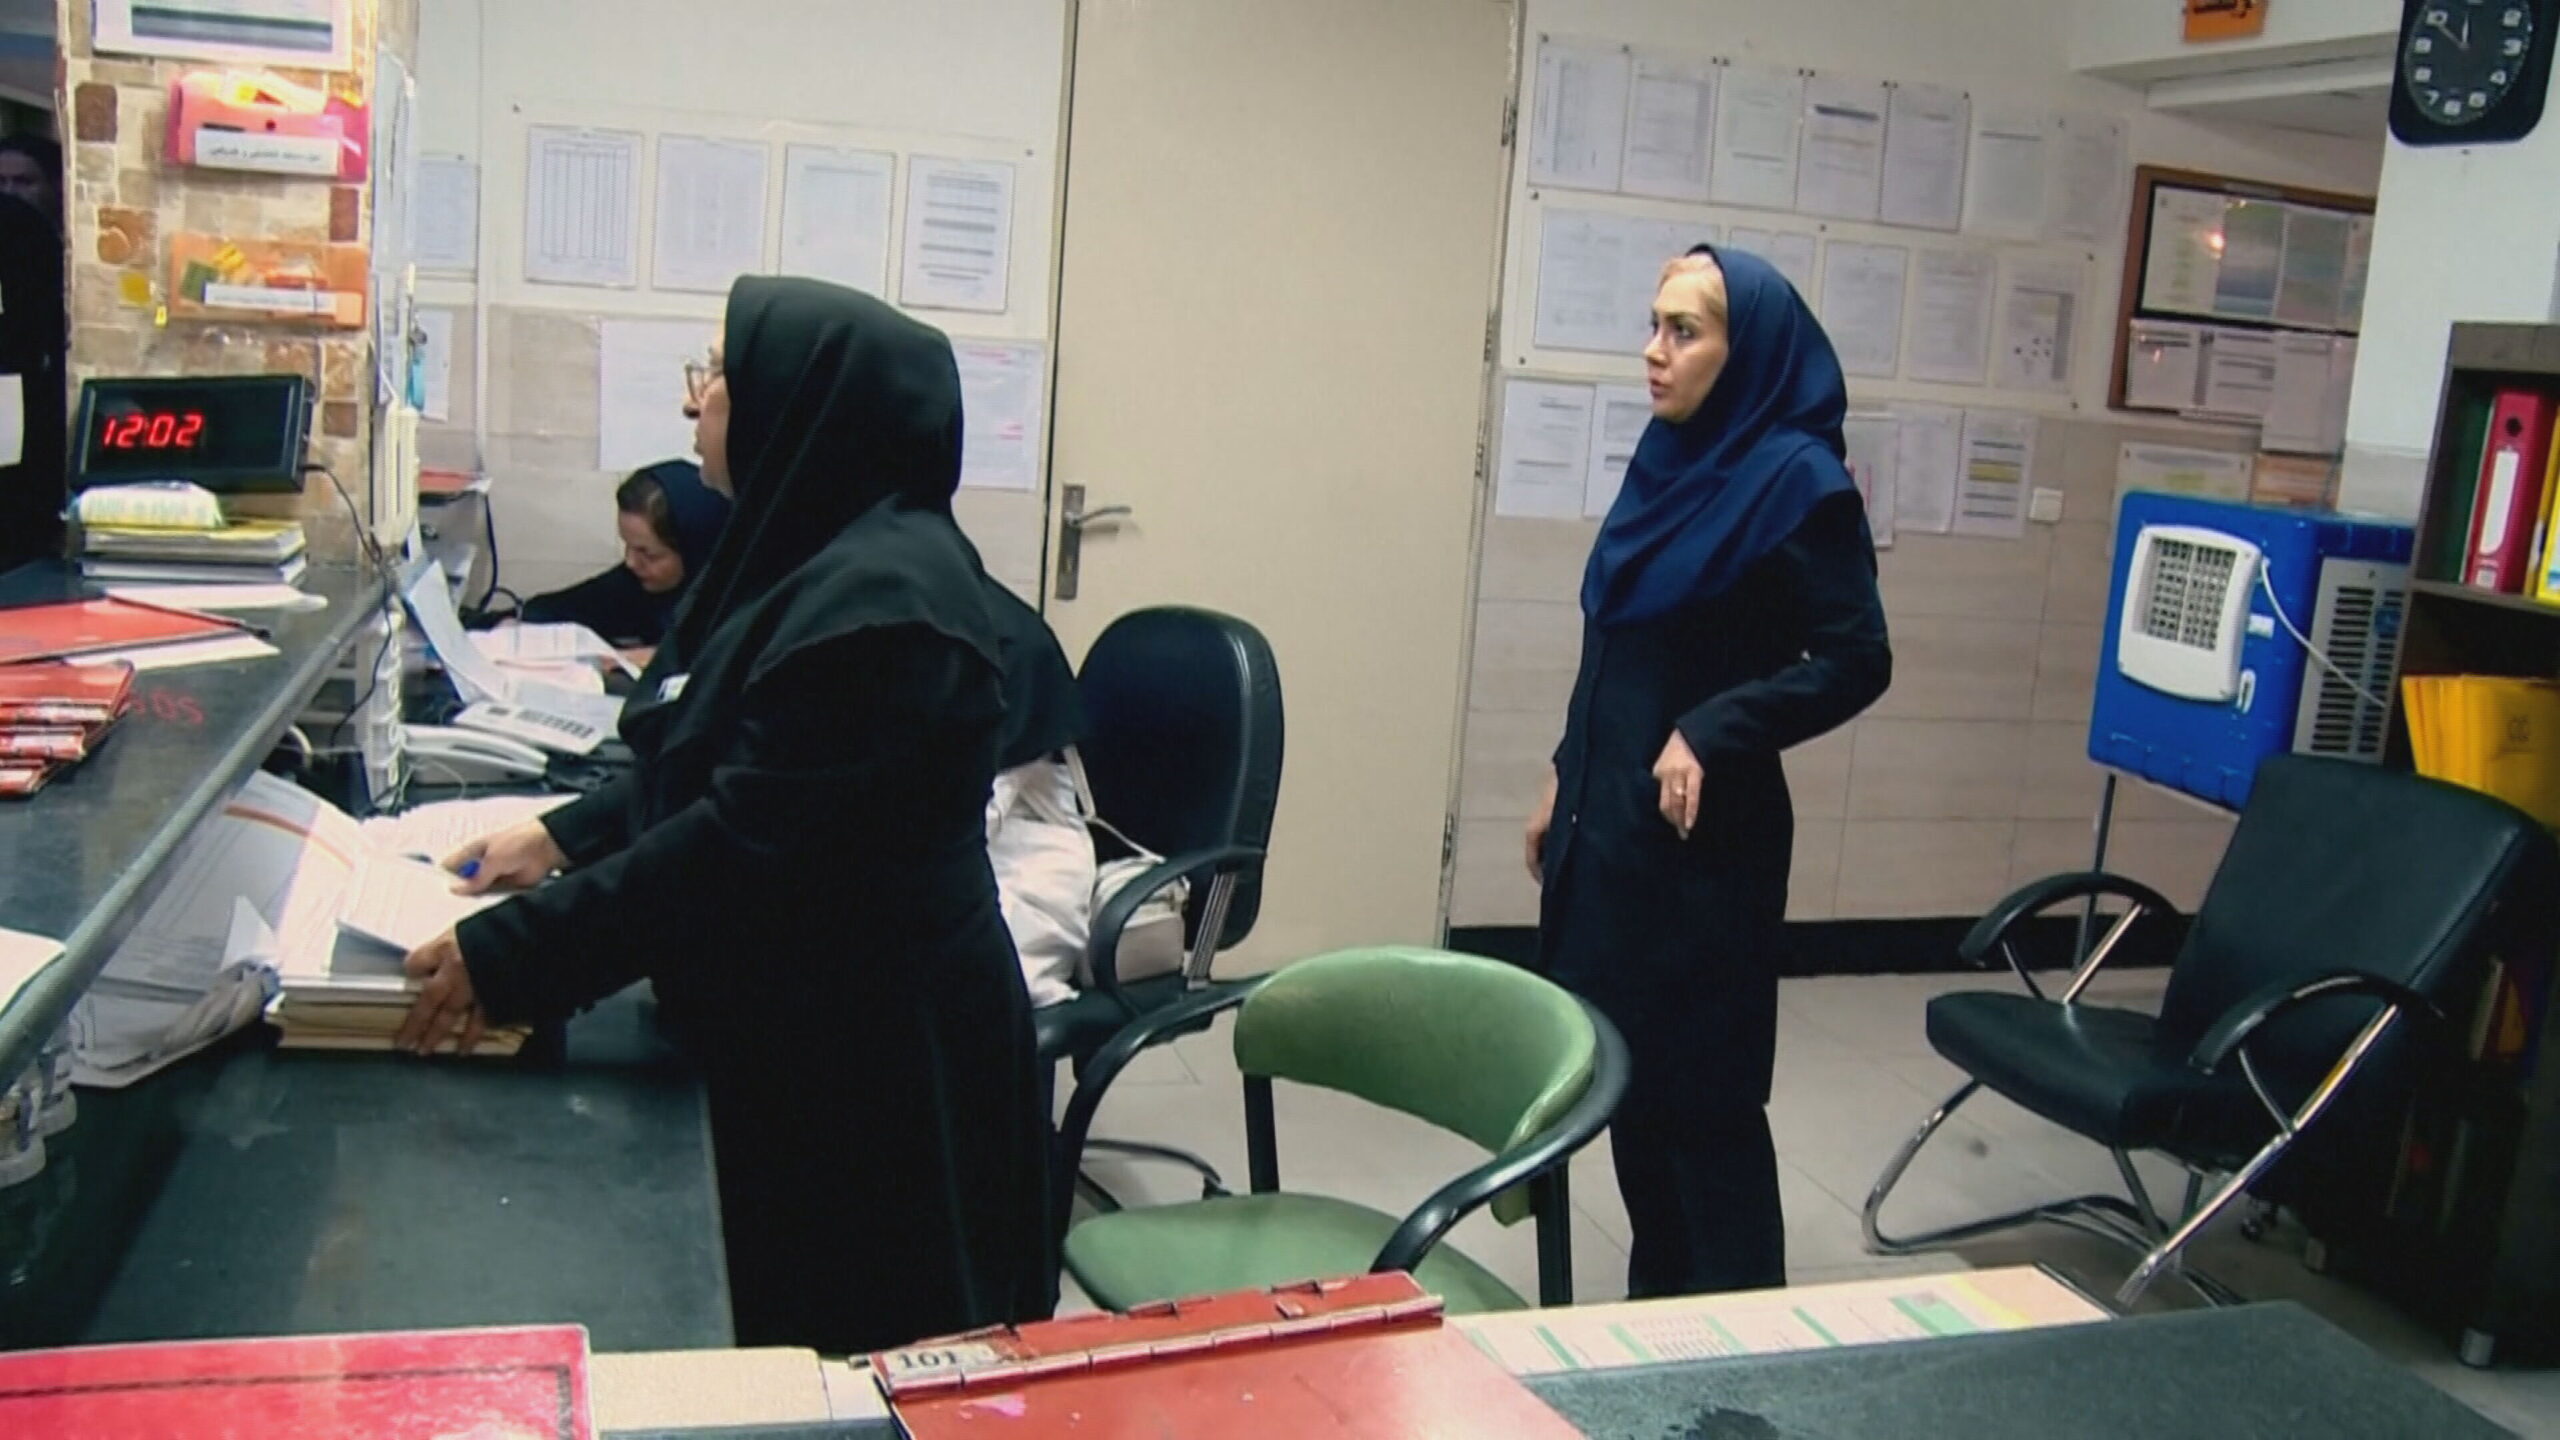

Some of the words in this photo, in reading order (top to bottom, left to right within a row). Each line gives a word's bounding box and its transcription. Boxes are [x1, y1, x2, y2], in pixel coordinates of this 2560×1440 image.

[2503, 38, 2522, 56] 3
[2423, 89, 2440, 107] 7
[898, 1350, 958, 1369] 101
